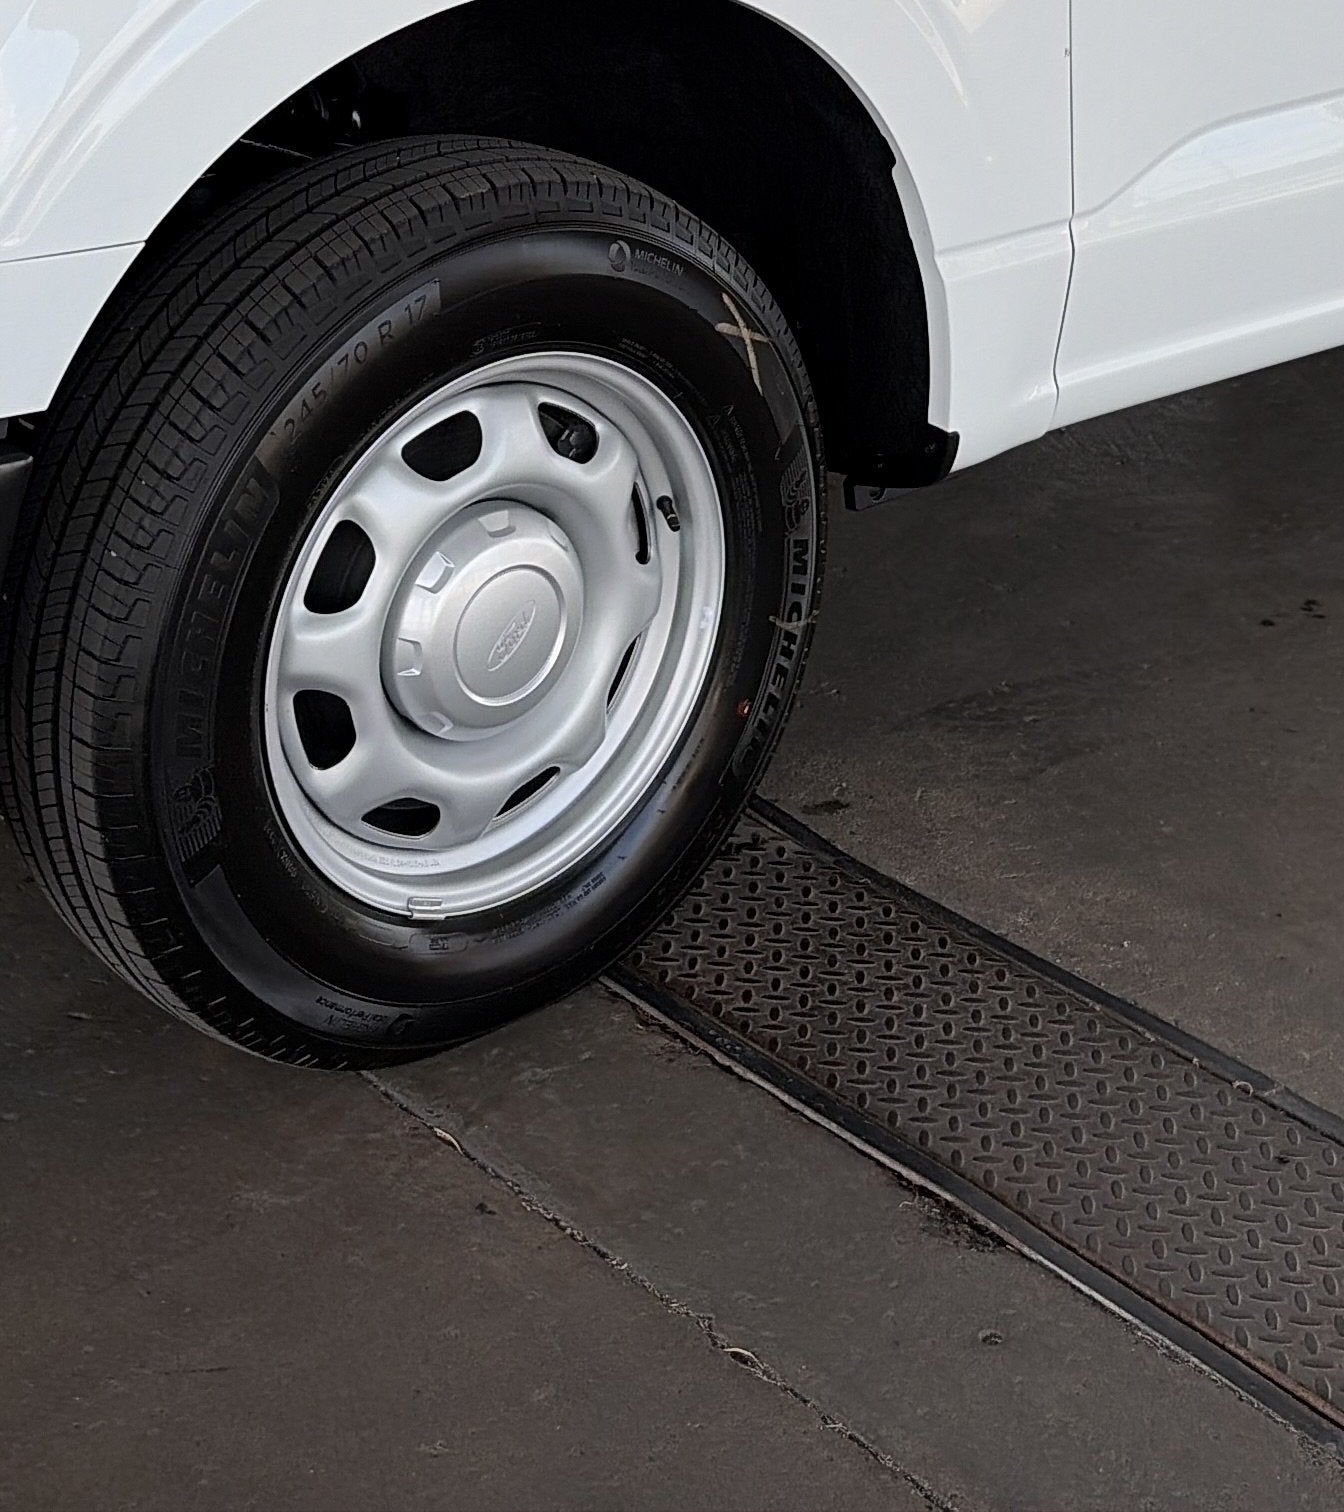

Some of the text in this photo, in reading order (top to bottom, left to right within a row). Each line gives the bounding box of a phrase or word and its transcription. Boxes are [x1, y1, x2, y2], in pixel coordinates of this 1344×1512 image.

[634, 248, 685, 276] MICHELIN
[377, 319, 393, 345] R
[405, 294, 427, 325] 17
